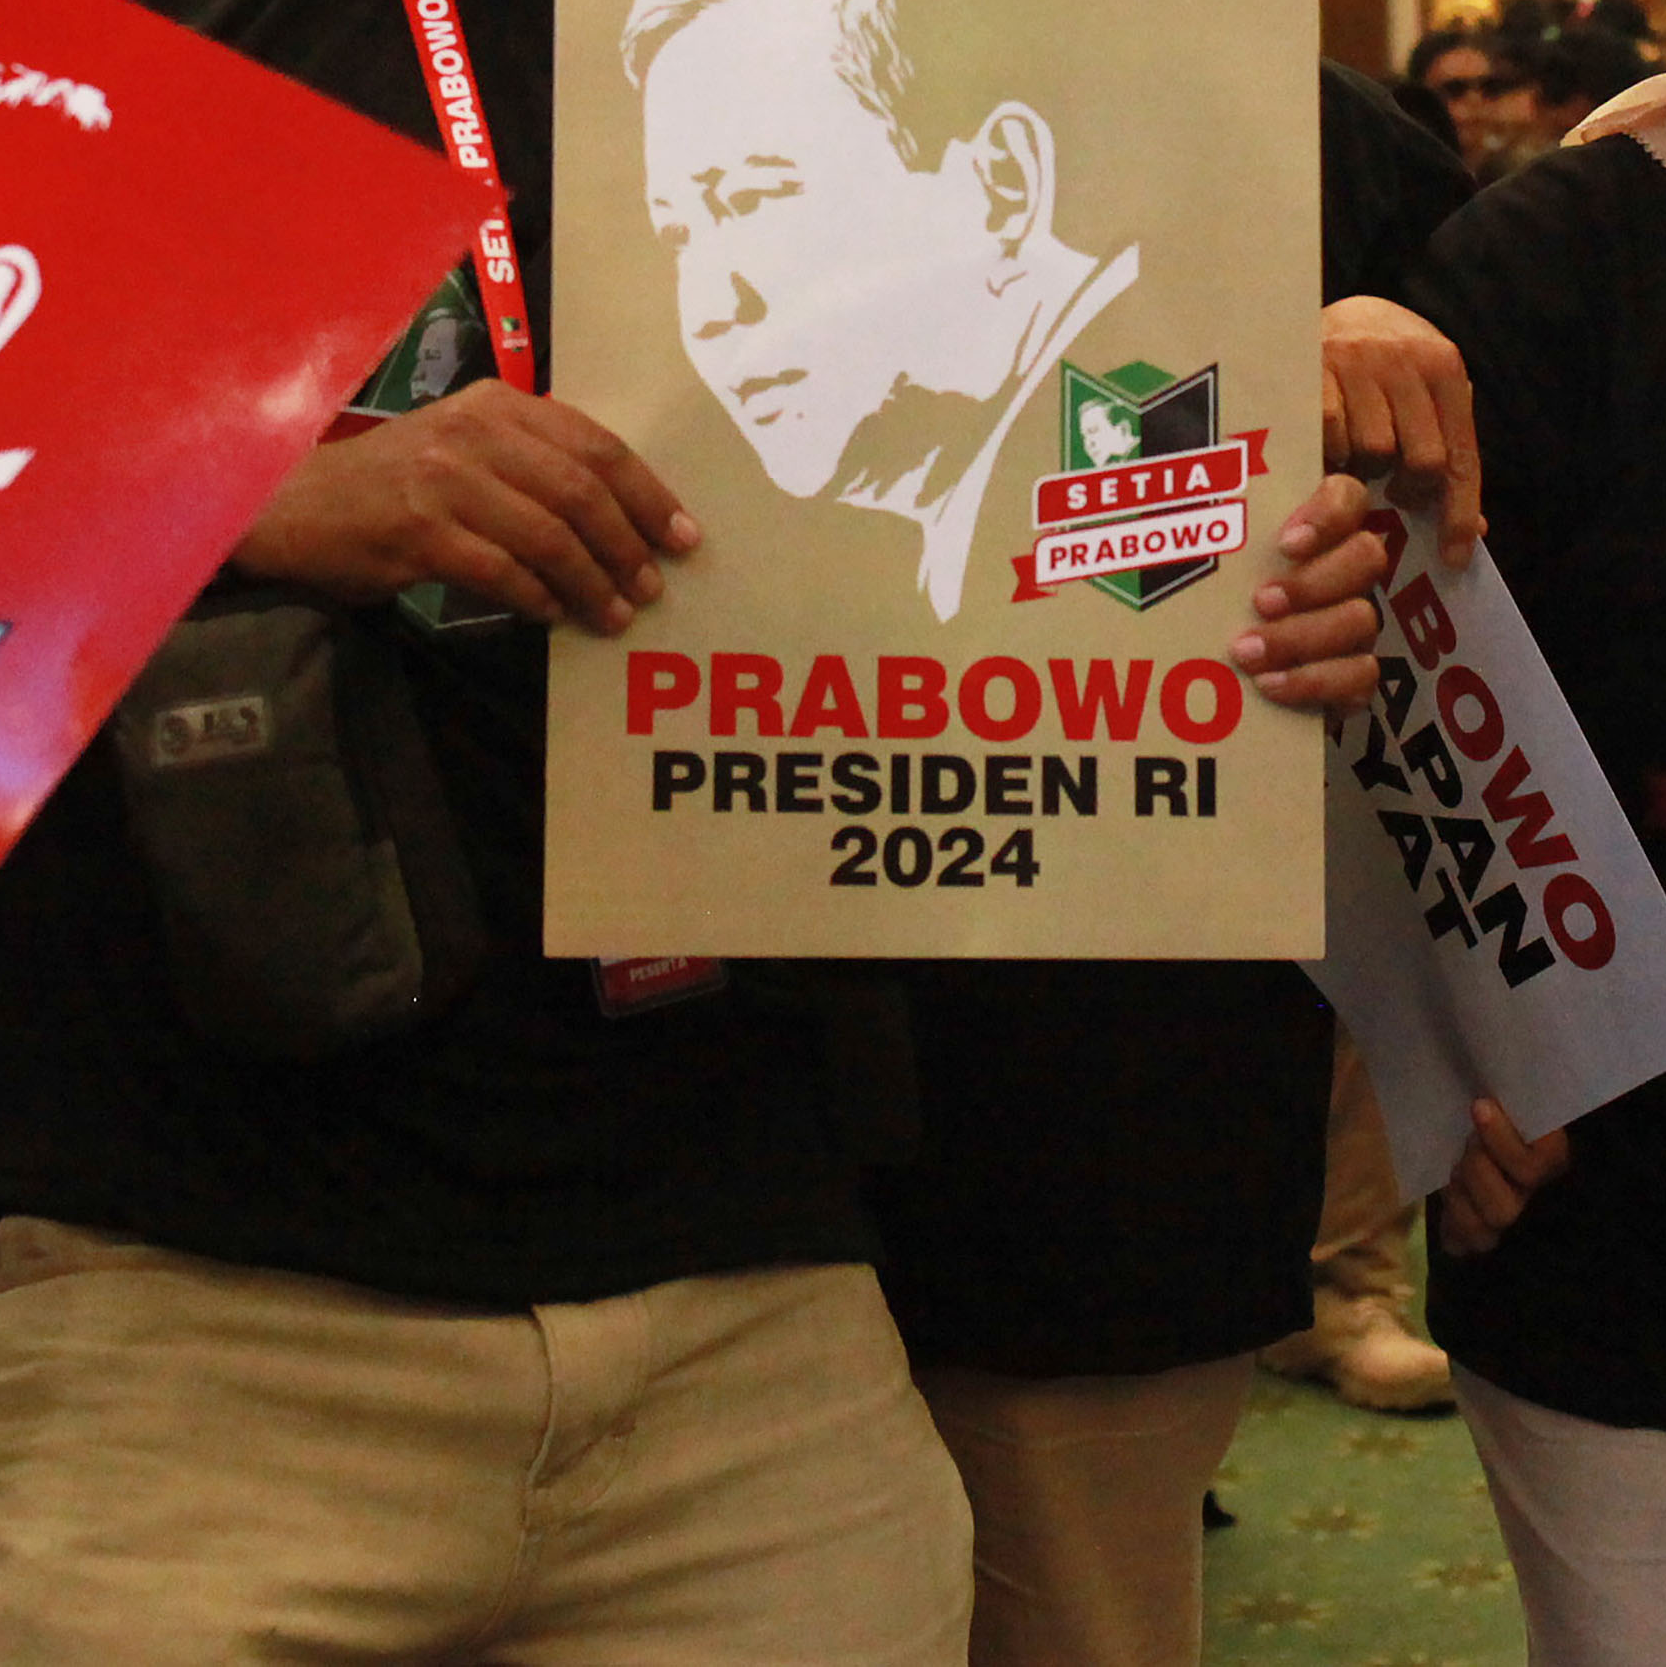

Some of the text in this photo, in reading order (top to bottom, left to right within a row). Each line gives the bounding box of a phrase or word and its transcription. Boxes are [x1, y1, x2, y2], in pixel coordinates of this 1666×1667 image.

[1065, 465, 1212, 510] SETIA
[1048, 518, 1233, 573] PRABOWO
[625, 651, 1244, 744] PRABOWO
[1363, 508, 1617, 971] ABOWO
[652, 750, 1218, 818] PRESIDEN RI
[1374, 593, 1557, 989] APAN
[829, 827, 1041, 889] 2024
